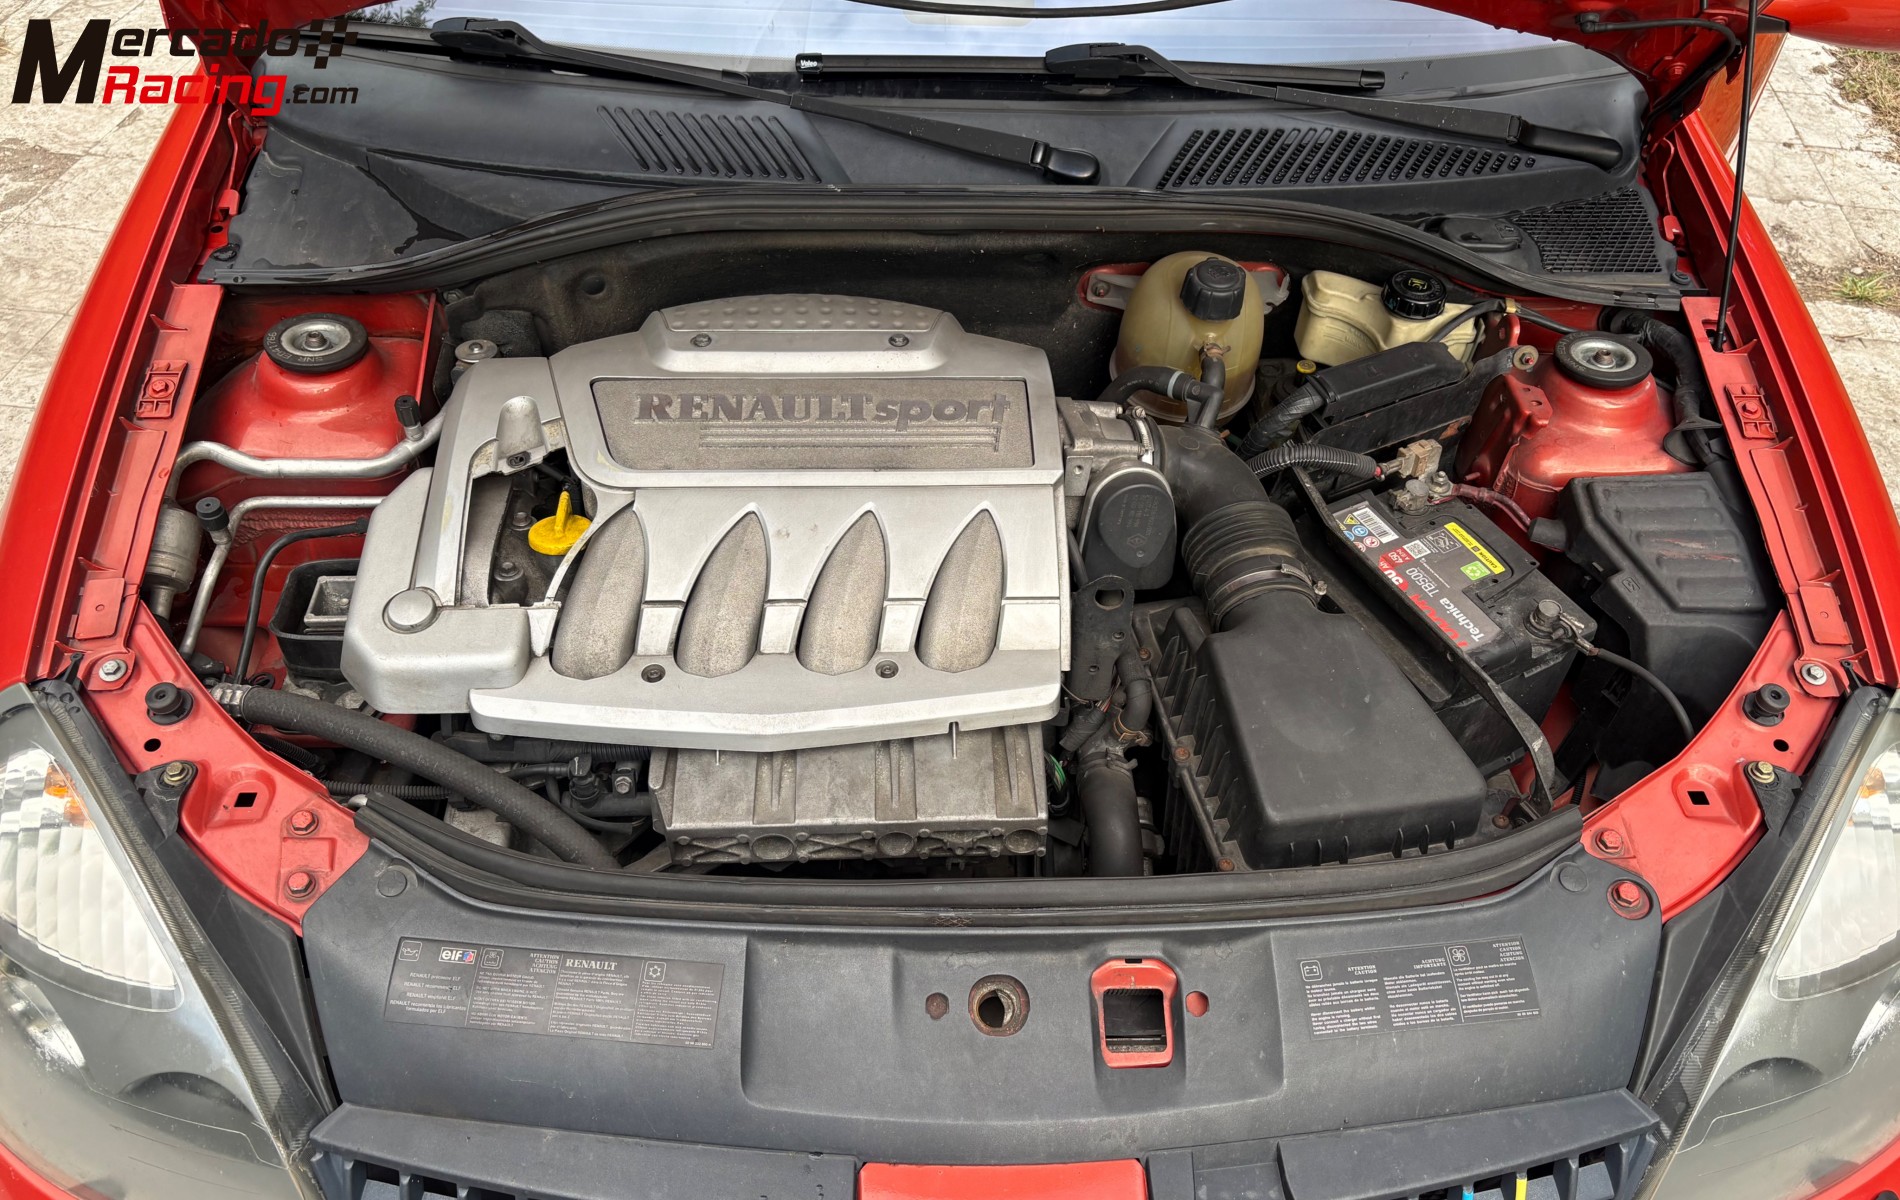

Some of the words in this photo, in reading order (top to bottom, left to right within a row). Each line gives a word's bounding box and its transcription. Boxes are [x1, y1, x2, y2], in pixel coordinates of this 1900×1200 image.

[1388, 551, 1404, 563] 450
[1405, 567, 1439, 598] TB500
[1439, 597, 1485, 642] Technica
[441, 949, 463, 961] elf
[565, 958, 618, 971] RENAULT
